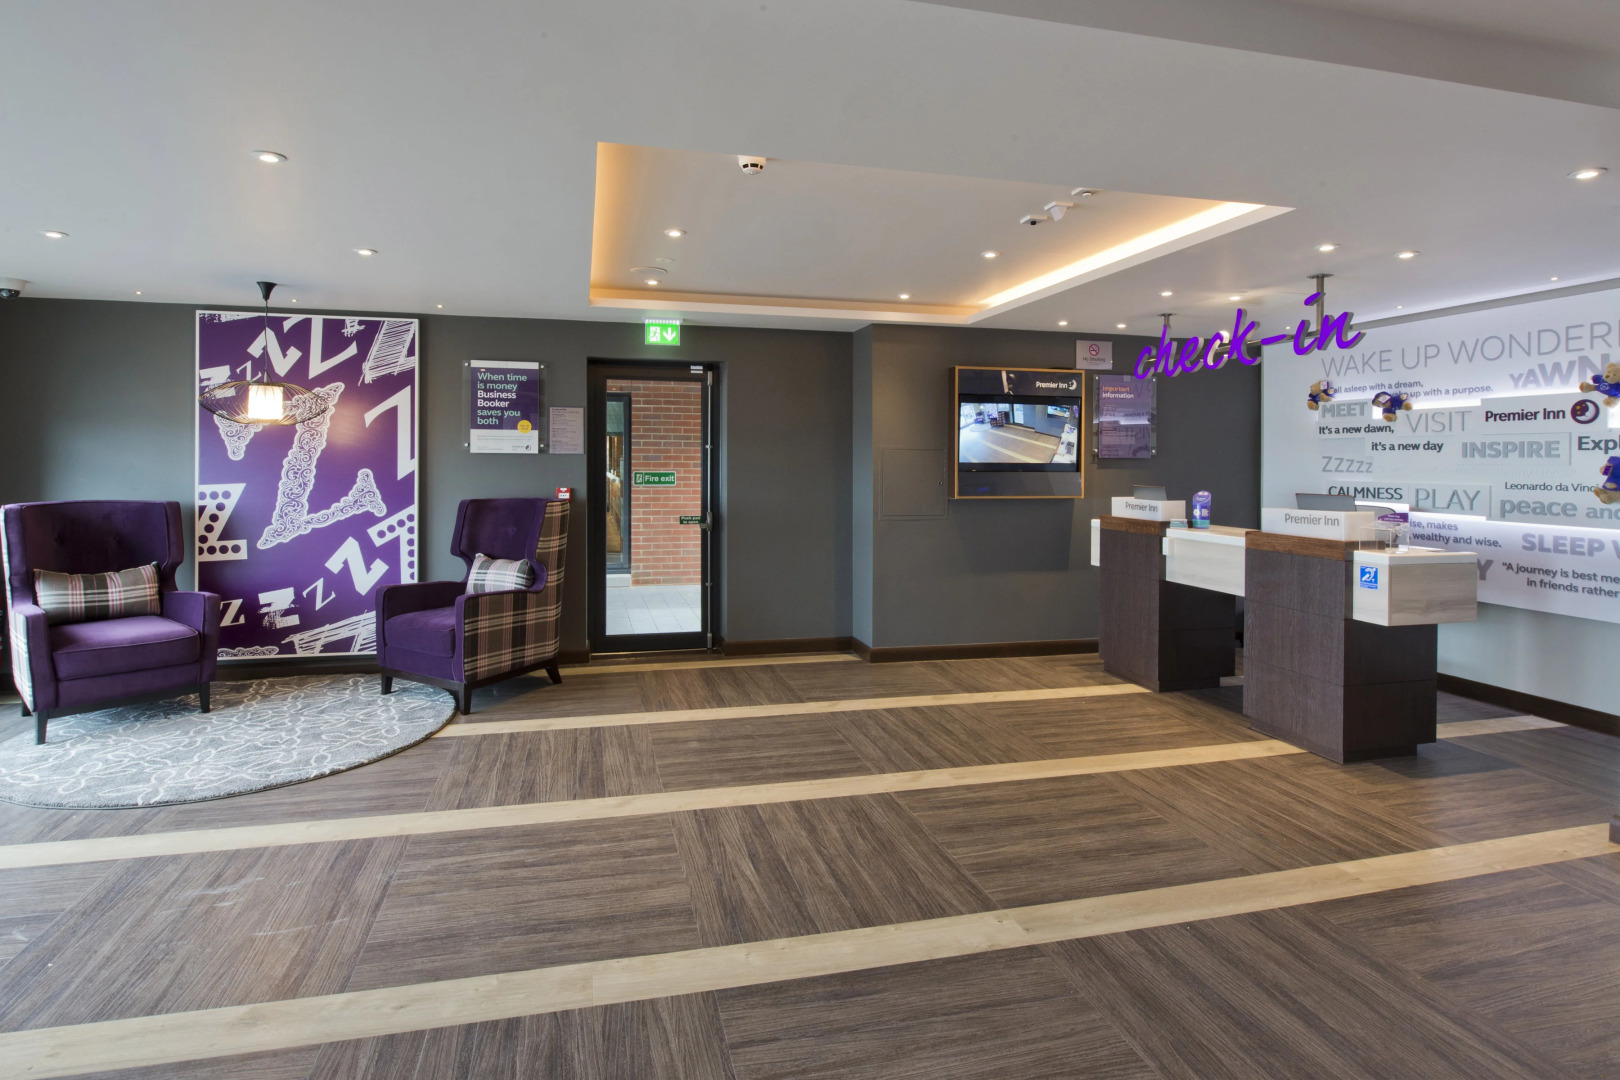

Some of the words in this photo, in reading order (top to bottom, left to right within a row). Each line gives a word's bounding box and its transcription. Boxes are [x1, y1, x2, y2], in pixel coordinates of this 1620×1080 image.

[1134, 291, 1364, 380] check-in
[1321, 350, 1393, 378] WAKE
[1401, 345, 1440, 370] UP
[1447, 318, 1620, 365] WONDER
[477, 372, 505, 380] When
[507, 373, 528, 381] time
[1508, 353, 1610, 388] YAWN
[477, 381, 485, 389] is
[487, 383, 518, 391] money
[1331, 384, 1342, 393] all
[1344, 384, 1367, 394] asleep
[1369, 382, 1386, 391] with
[1394, 380, 1423, 390] dream,
[1410, 391, 1421, 400] up
[1423, 388, 1442, 397] with
[1452, 385, 1494, 396] purpose.
[477, 390, 517, 399] Business
[477, 399, 509, 407] Booker
[1321, 402, 1368, 418] MEET
[477, 417, 499, 425] both
[504, 410, 521, 418] you
[1485, 409, 1540, 422] Premier
[1543, 408, 1566, 420] Inn
[1405, 410, 1472, 433] VISIT
[1318, 425, 1333, 435] It's
[1344, 426, 1362, 434] new
[1364, 424, 1395, 435] dawn,
[1371, 441, 1387, 451] it's
[1388, 443, 1395, 451] a
[1398, 442, 1421, 451] new
[1422, 440, 1444, 453] day
[1461, 440, 1561, 458] INSPIRE
[1577, 435, 1620, 455] Exp
[1504, 482, 1553, 491] Leonardo
[1555, 482, 1569, 492] da
[1414, 487, 1481, 511] PLAY
[1125, 501, 1148, 511] Premier
[1148, 503, 1158, 512] Inn
[1500, 498, 1578, 519] peace
[1284, 513, 1322, 526] Premier
[1324, 515, 1340, 527] Inn
[1410, 519, 1425, 529] ise,
[1427, 520, 1458, 531] makes
[1412, 531, 1451, 545] wealthy
[1453, 535, 1472, 545] and
[1474, 537, 1502, 548] wise.
[1522, 532, 1605, 557] SLEEP
[1515, 563, 1557, 578] journey
[1560, 568, 1569, 578] is
[1572, 570, 1597, 582] best
[1526, 577, 1537, 588] in
[1539, 579, 1579, 593] friends
[1581, 586, 1620, 598] rather
